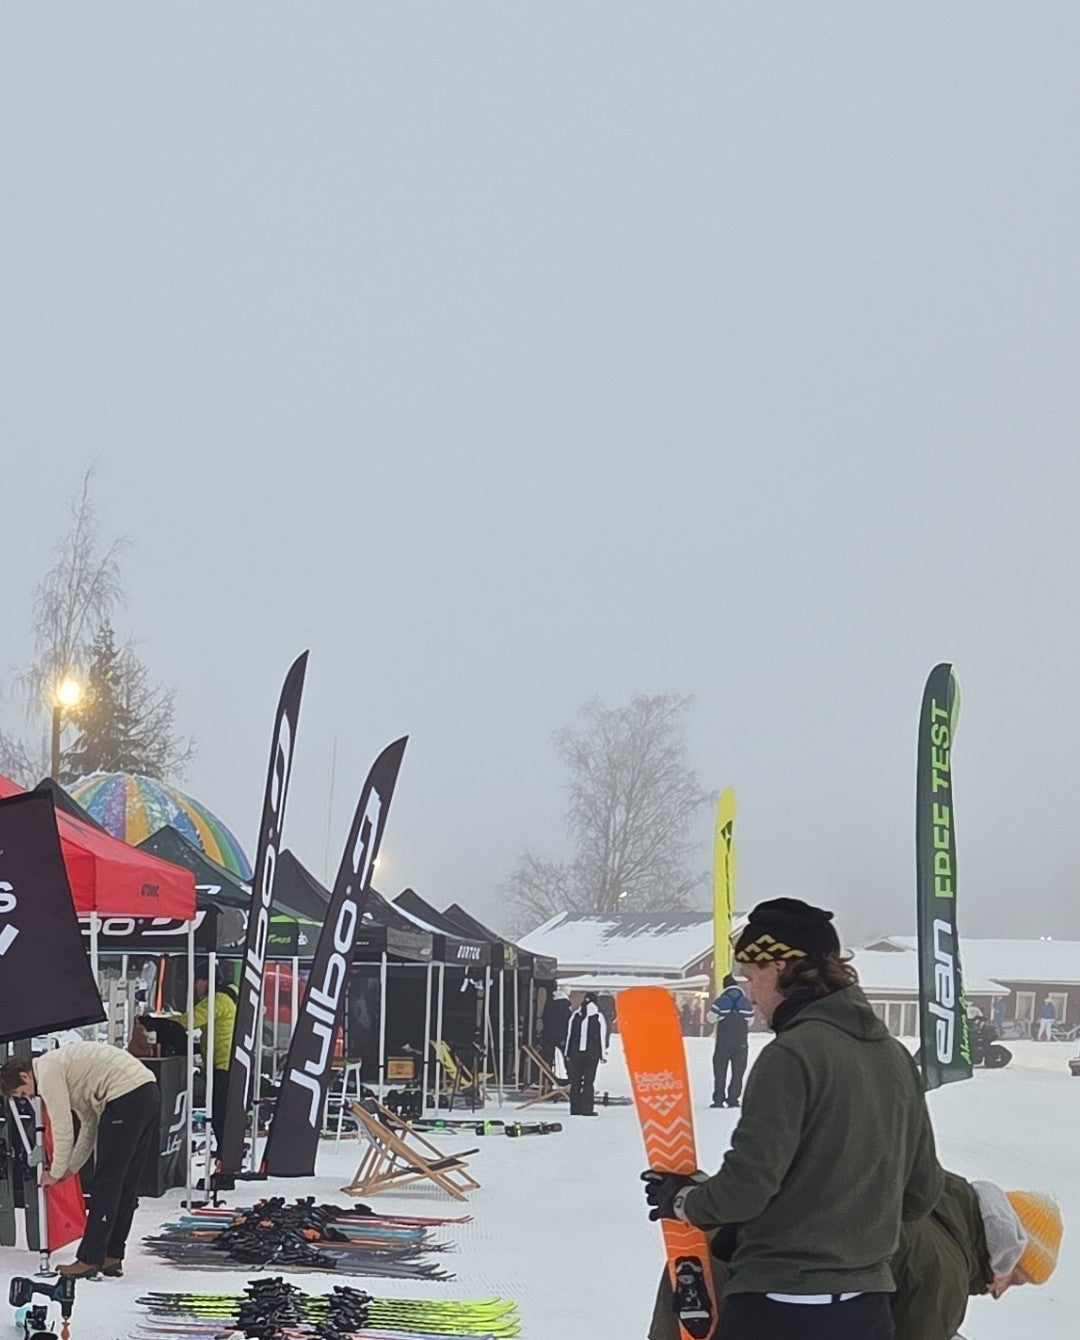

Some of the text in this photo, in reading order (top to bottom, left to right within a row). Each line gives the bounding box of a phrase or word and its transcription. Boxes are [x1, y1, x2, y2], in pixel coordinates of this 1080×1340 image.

[931, 697, 950, 794] TEST
[234, 842, 277, 1112] Julbo
[289, 898, 358, 1128] Julbo
[928, 918, 955, 1064] elan
